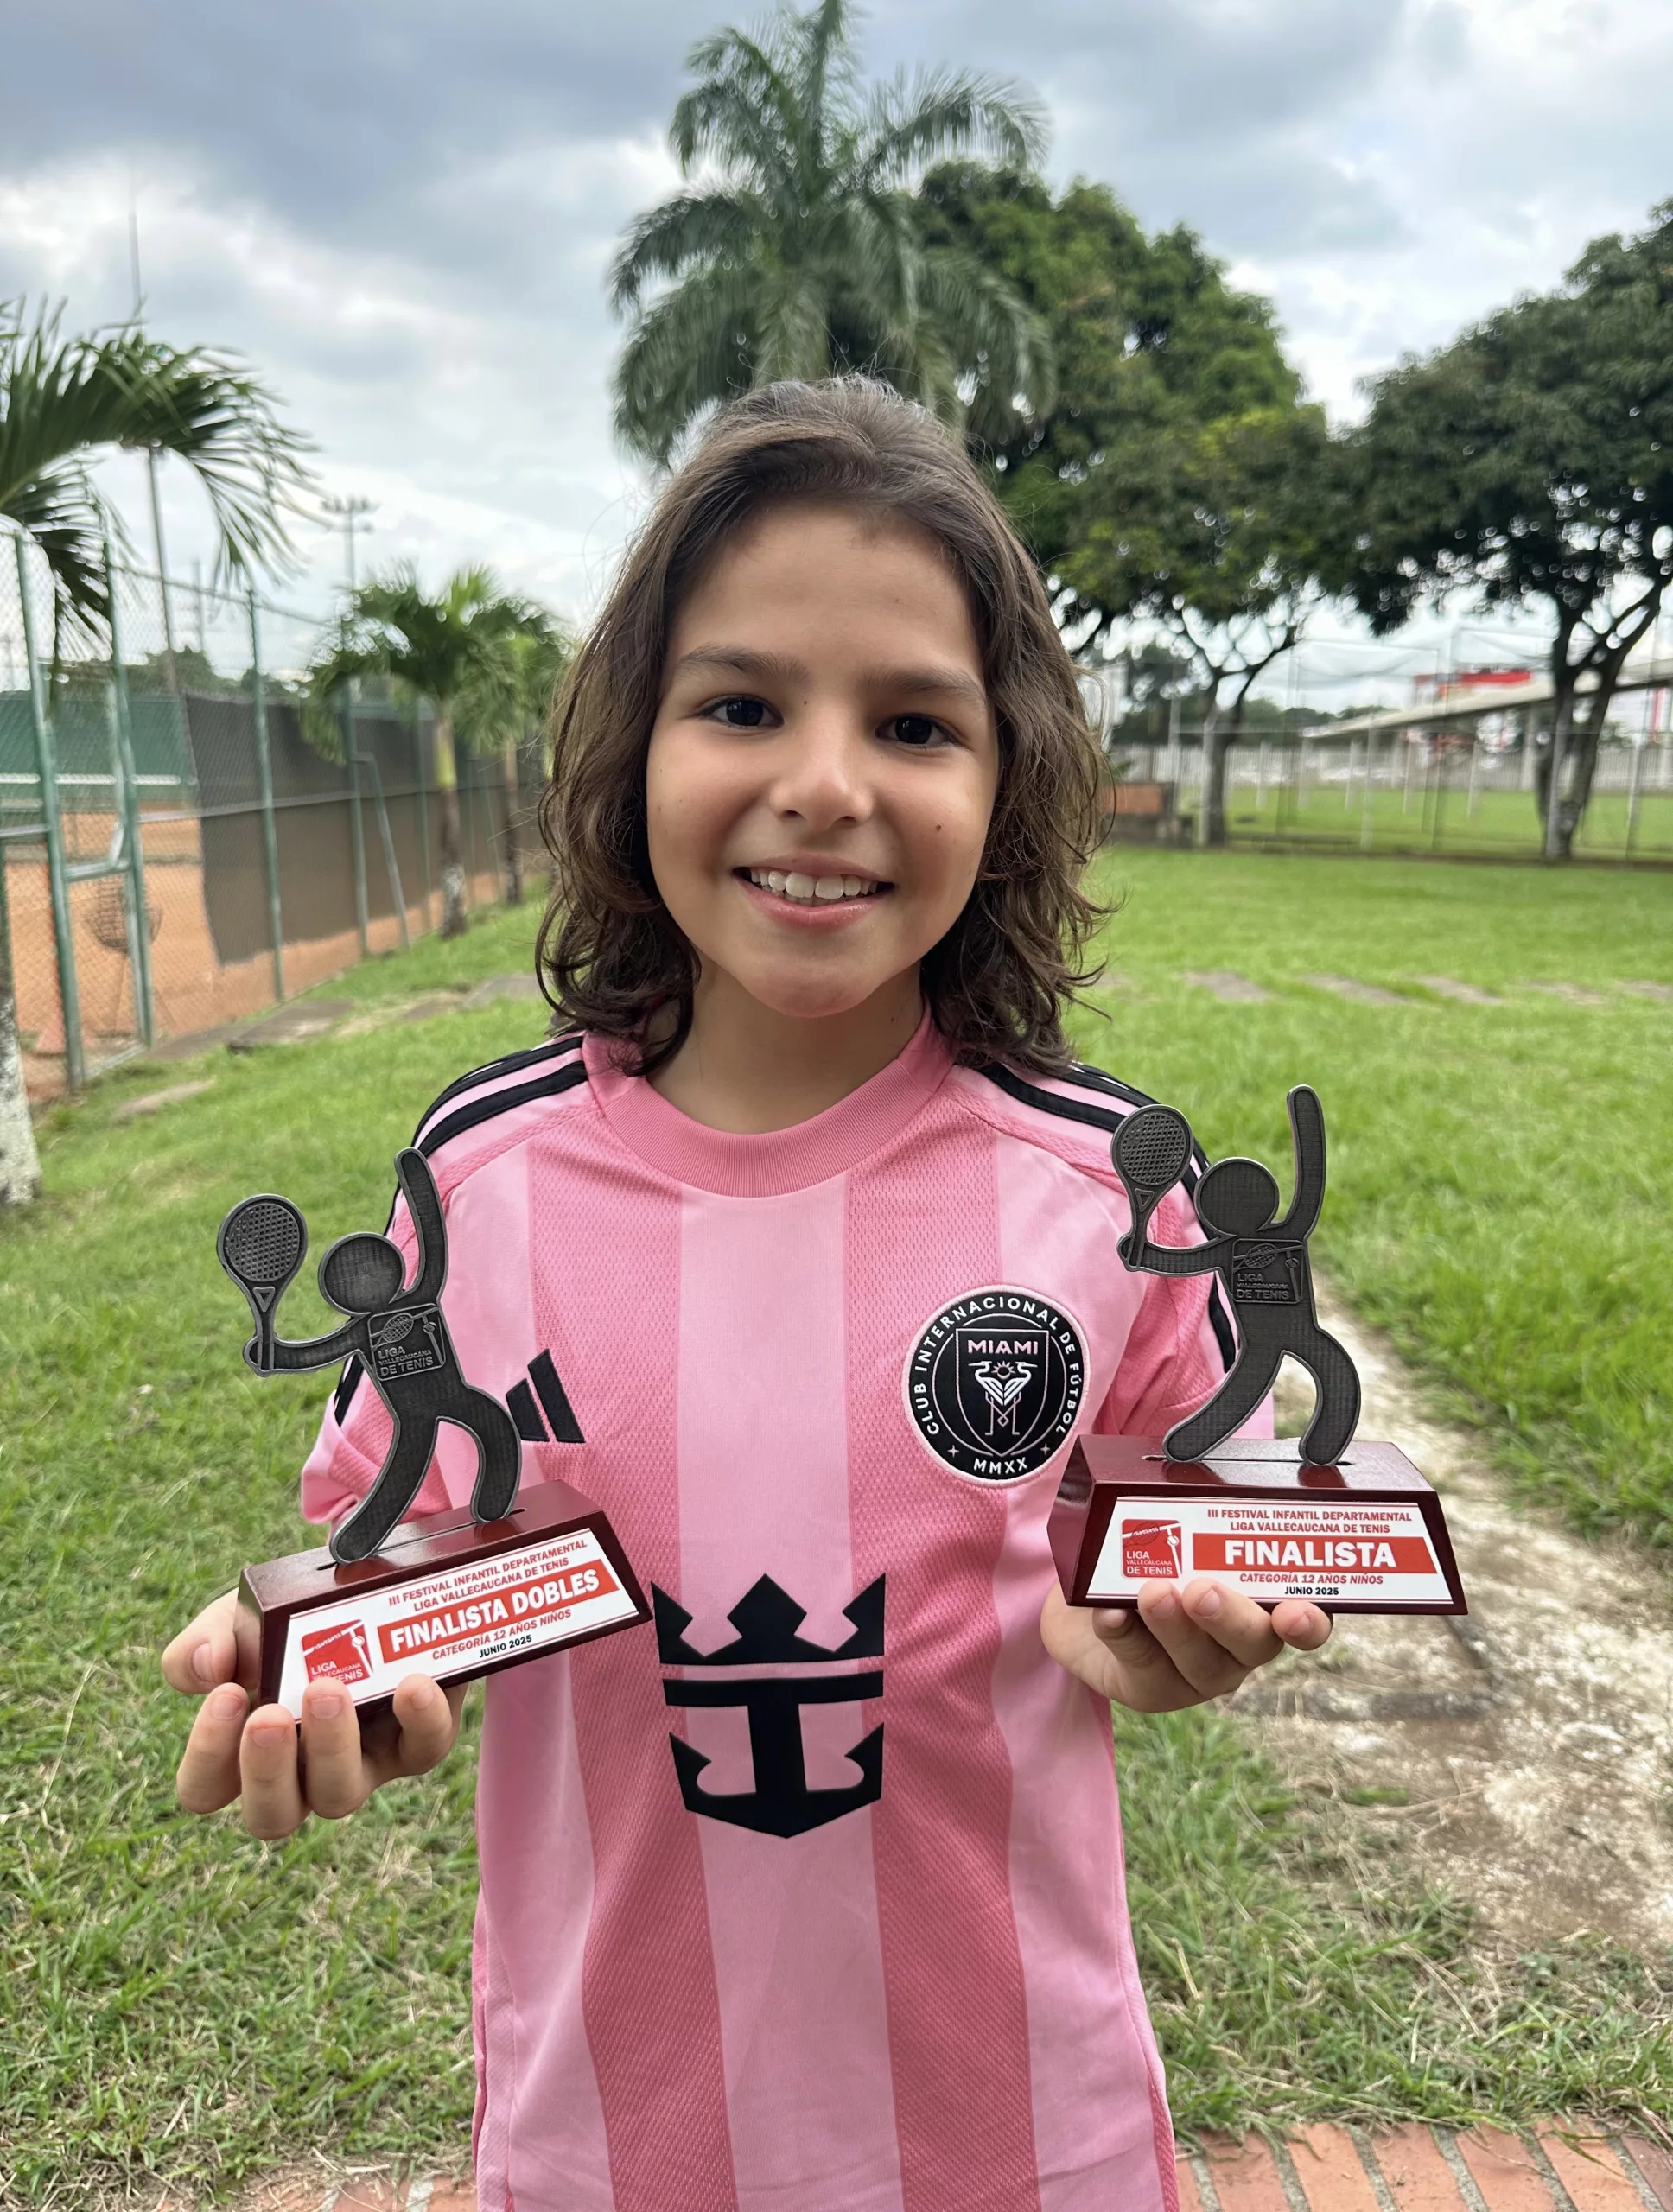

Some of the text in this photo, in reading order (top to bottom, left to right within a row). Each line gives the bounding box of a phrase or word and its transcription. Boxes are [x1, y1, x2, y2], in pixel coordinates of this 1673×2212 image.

[1237, 1274, 1263, 1282] LIGA
[1237, 1290, 1289, 1300] DE TENIS
[378, 1346, 405, 1359] LIGA
[968, 1340, 1038, 1355] MIAMI
[378, 1350, 432, 1366] VALLECAUCANA
[914, 1296, 1082, 1435] CLUB INTERNACIONAL DE FÚTBOL
[380, 1357, 433, 1376] DE TENIS
[973, 1457, 1028, 1475] MMXX
[1207, 1509, 1412, 1521] III FESTIVAL INFANTIL DEPARTAMENTAL
[1230, 1522, 1390, 1534] LIGA VALLECAUCANA DE TENIS
[1126, 1550, 1150, 1560] LIGA
[1225, 1540, 1397, 1567] FINALISTA
[389, 1540, 588, 1605] III FESTIVAL INFANTIL DEPARTAMENTAL
[1127, 1566, 1173, 1575] DE TENIS
[1240, 1572, 1384, 1584] CATEGORÍA 12 AÑOS NIÑOS
[414, 1557, 569, 1611] LIGA VALLECAUCANA DE TENIS
[1285, 1586, 1313, 1595] JUNIO
[390, 1568, 600, 1652] FINALISTA DOBLES
[432, 1609, 571, 1660] CATEGORÍA 12 AÑOS NIÑOS
[480, 1634, 532, 1658] JUNIO 2025
[311, 1661, 337, 1675] LIGA
